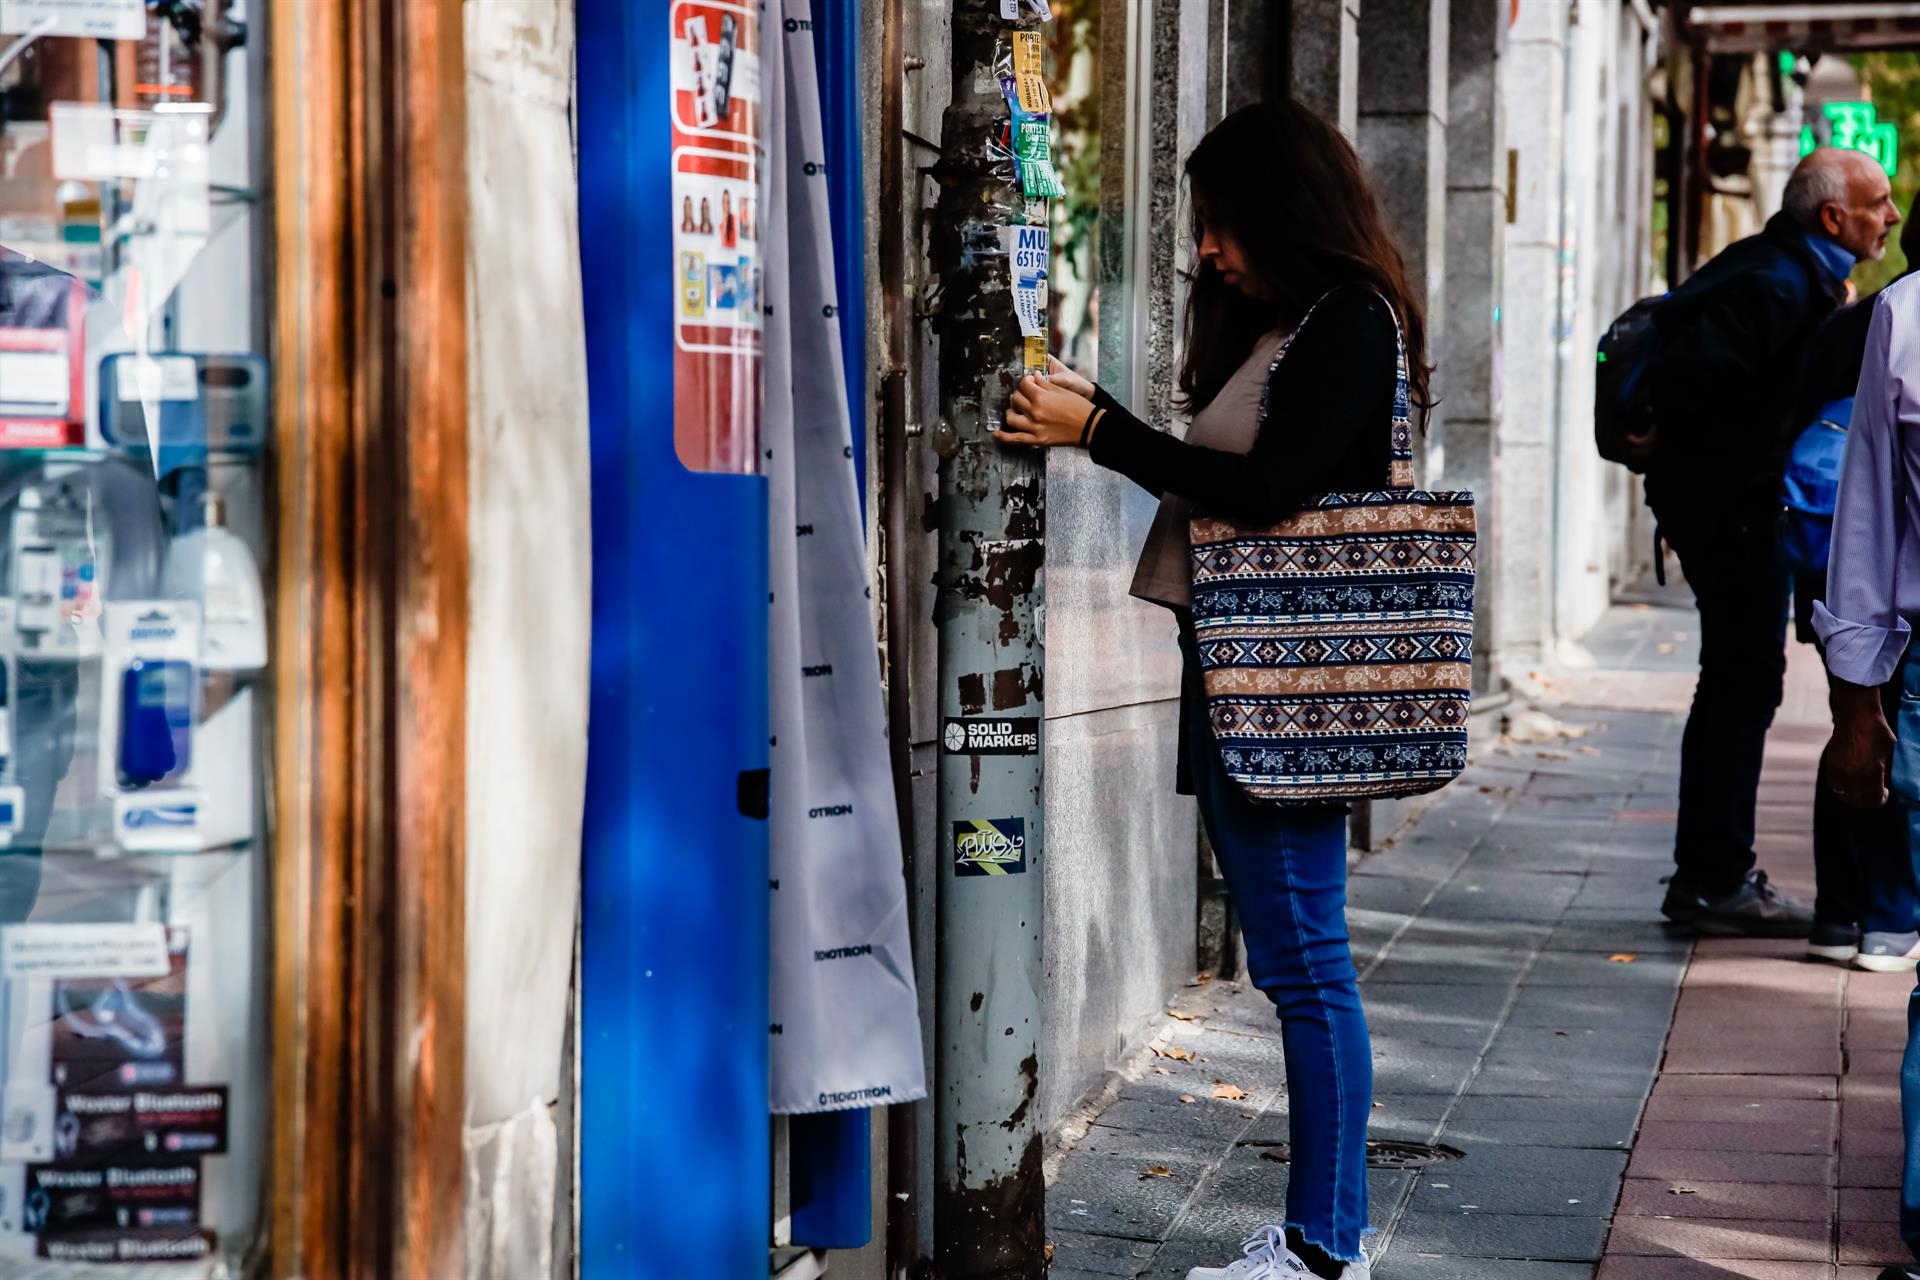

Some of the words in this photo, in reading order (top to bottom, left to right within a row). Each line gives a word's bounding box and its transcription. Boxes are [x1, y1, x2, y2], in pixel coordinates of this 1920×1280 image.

[1019, 229, 1049, 251] MU
[1017, 251, 1034, 267] 651
[968, 722, 1012, 736] SOLID
[969, 733, 1037, 749] MARKERS
